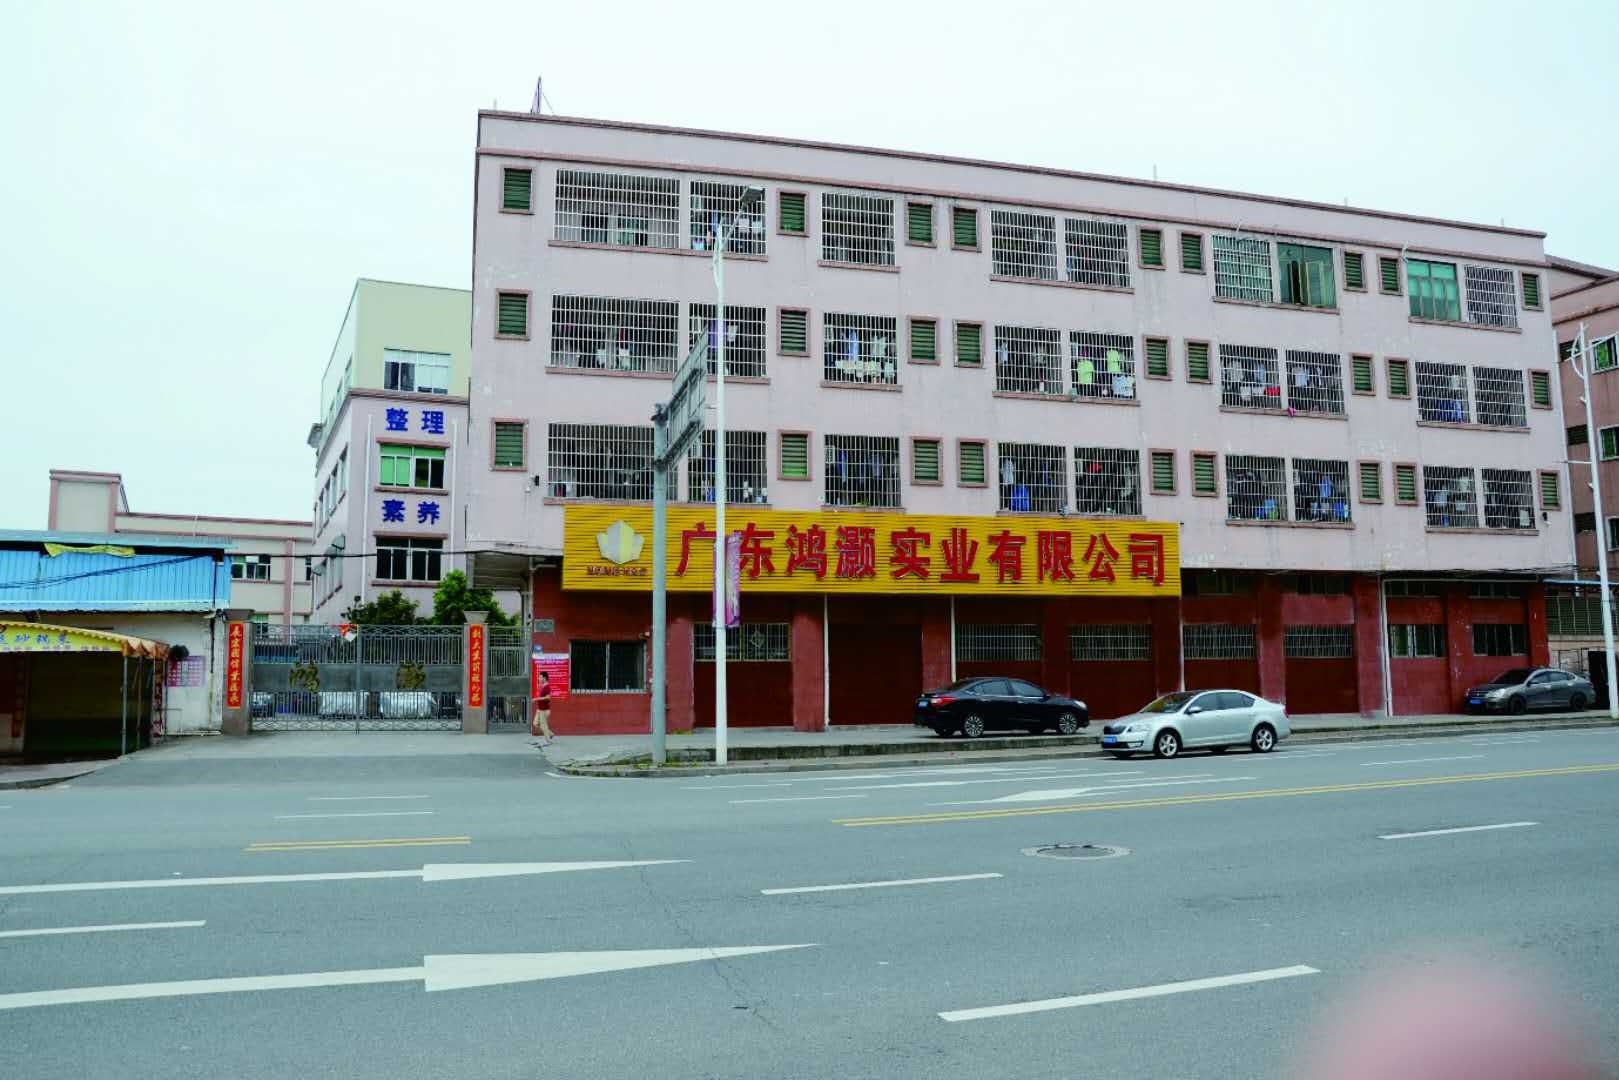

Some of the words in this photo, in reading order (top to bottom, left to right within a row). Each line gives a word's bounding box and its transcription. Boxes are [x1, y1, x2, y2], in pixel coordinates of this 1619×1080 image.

[385, 407, 445, 435] 整理
[382, 499, 441, 525] 素养
[676, 520, 1166, 586] 广东鸿灏实业有限公司
